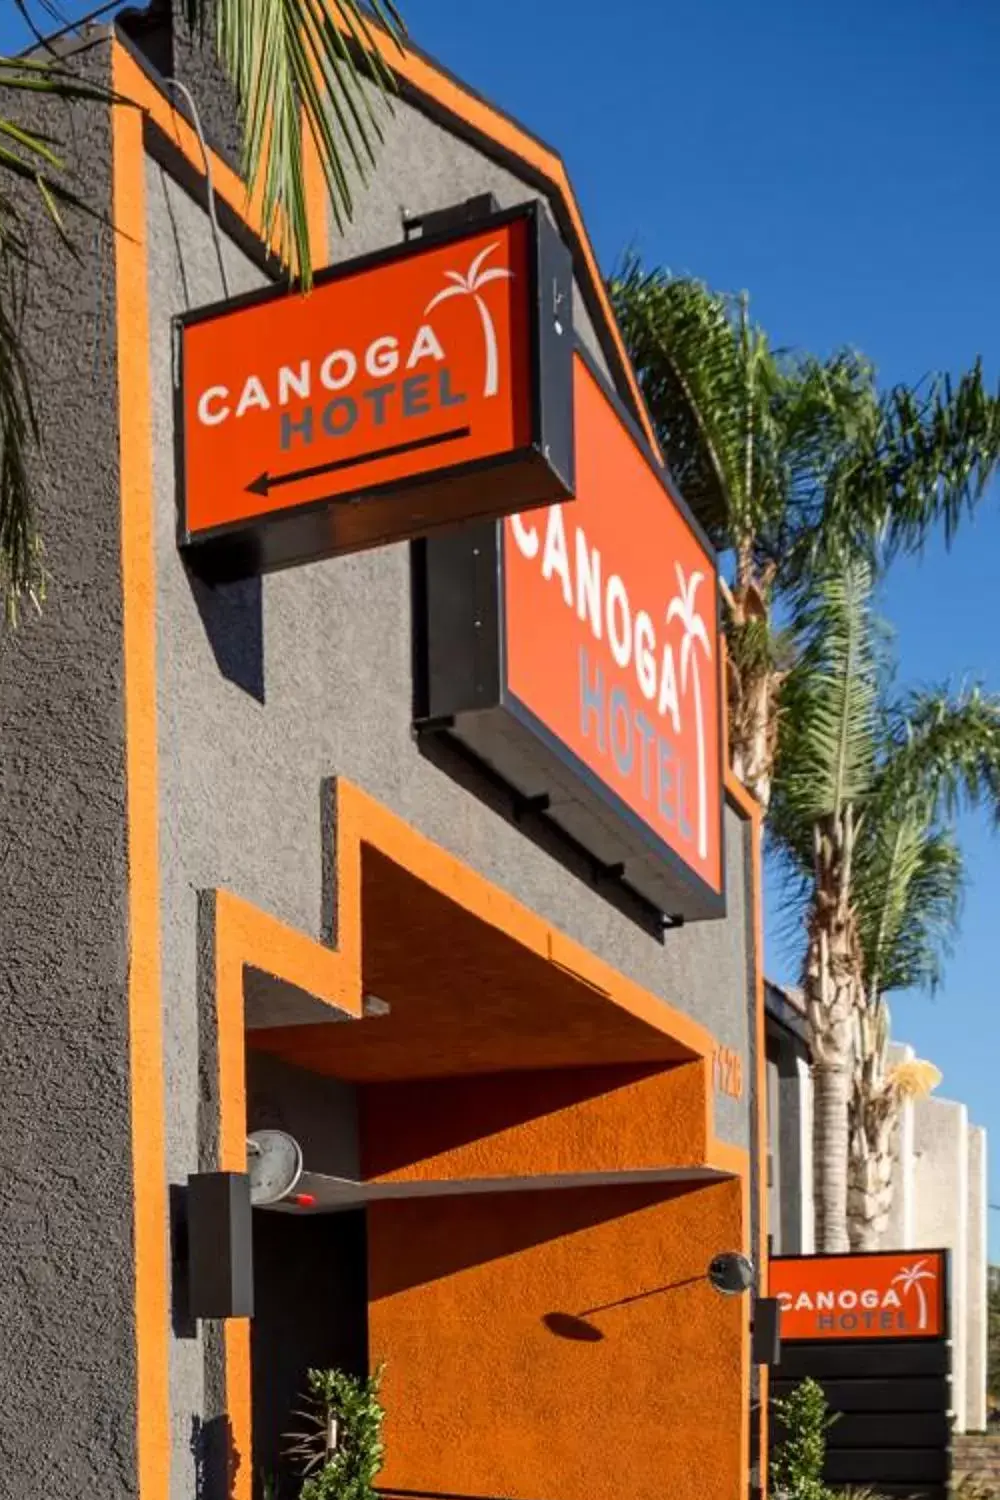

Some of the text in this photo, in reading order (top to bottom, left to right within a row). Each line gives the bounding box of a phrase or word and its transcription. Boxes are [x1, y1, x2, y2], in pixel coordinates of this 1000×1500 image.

[197, 324, 446, 427] CANOGA
[280, 367, 468, 451] HOTEL
[578, 645, 694, 842] HOTEL
[817, 1311, 910, 1331] HOTEL
